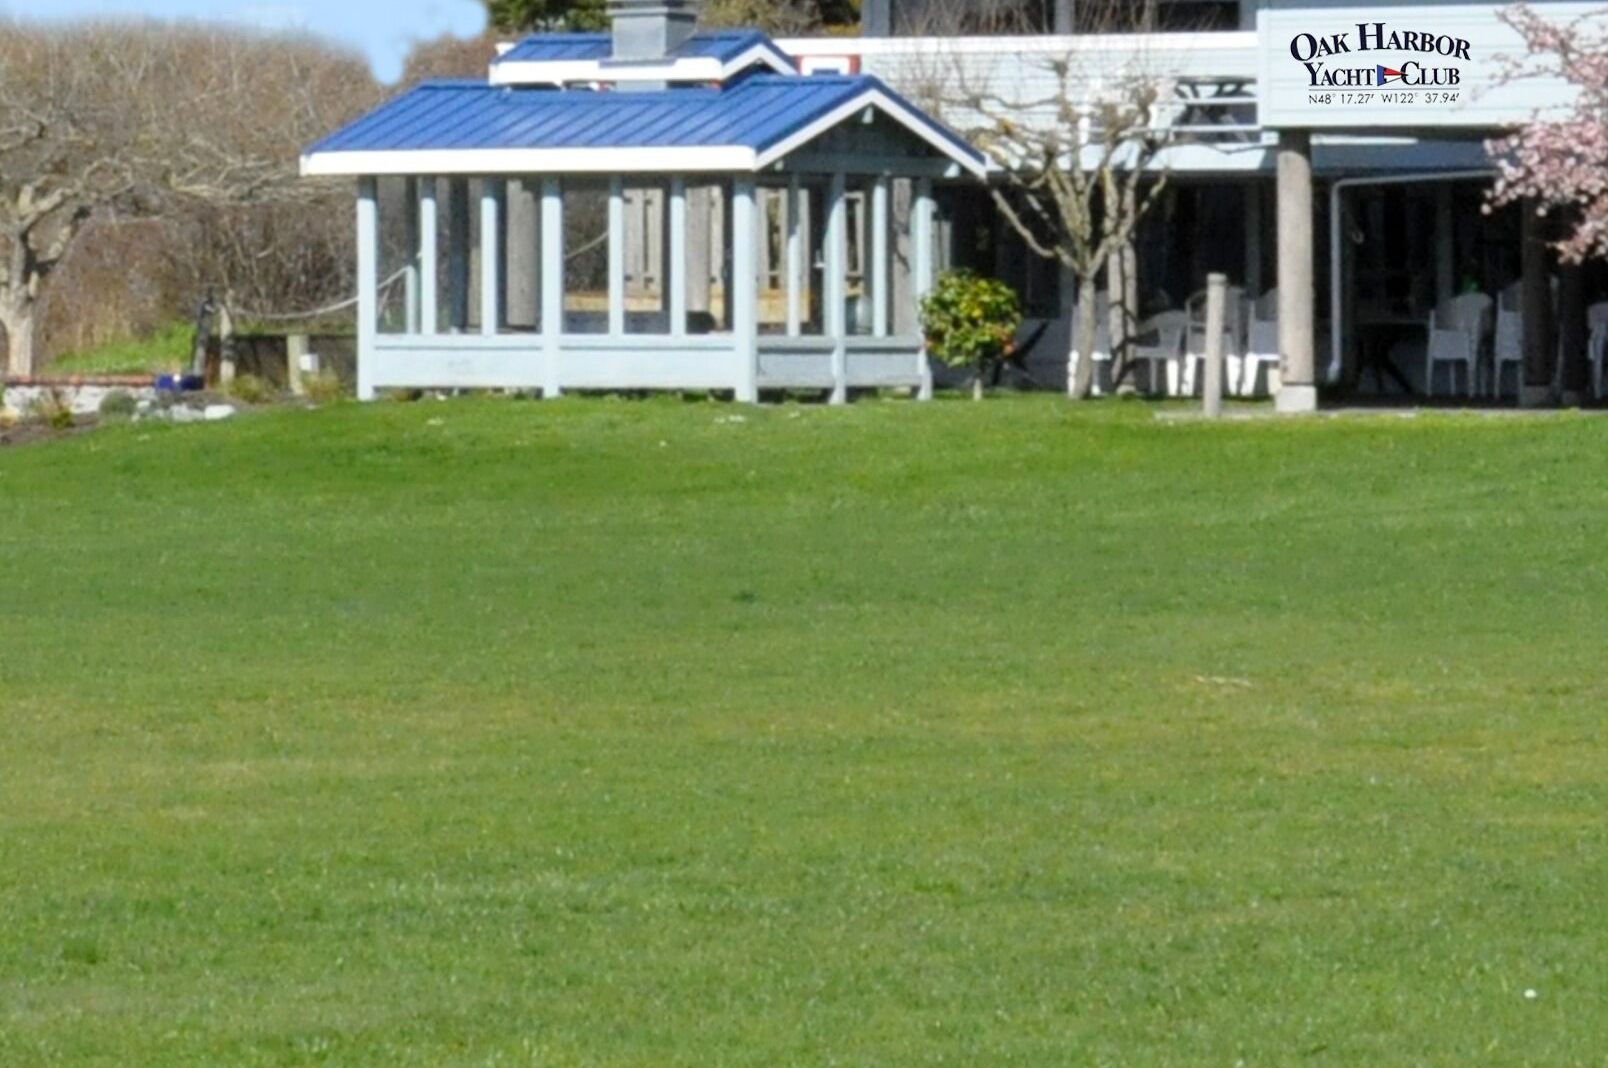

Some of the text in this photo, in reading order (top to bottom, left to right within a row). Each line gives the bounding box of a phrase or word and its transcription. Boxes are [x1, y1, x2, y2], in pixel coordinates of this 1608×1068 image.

[1290, 23, 1471, 61] OAK HARBOR
[1304, 61, 1460, 86] YACHT CLUB
